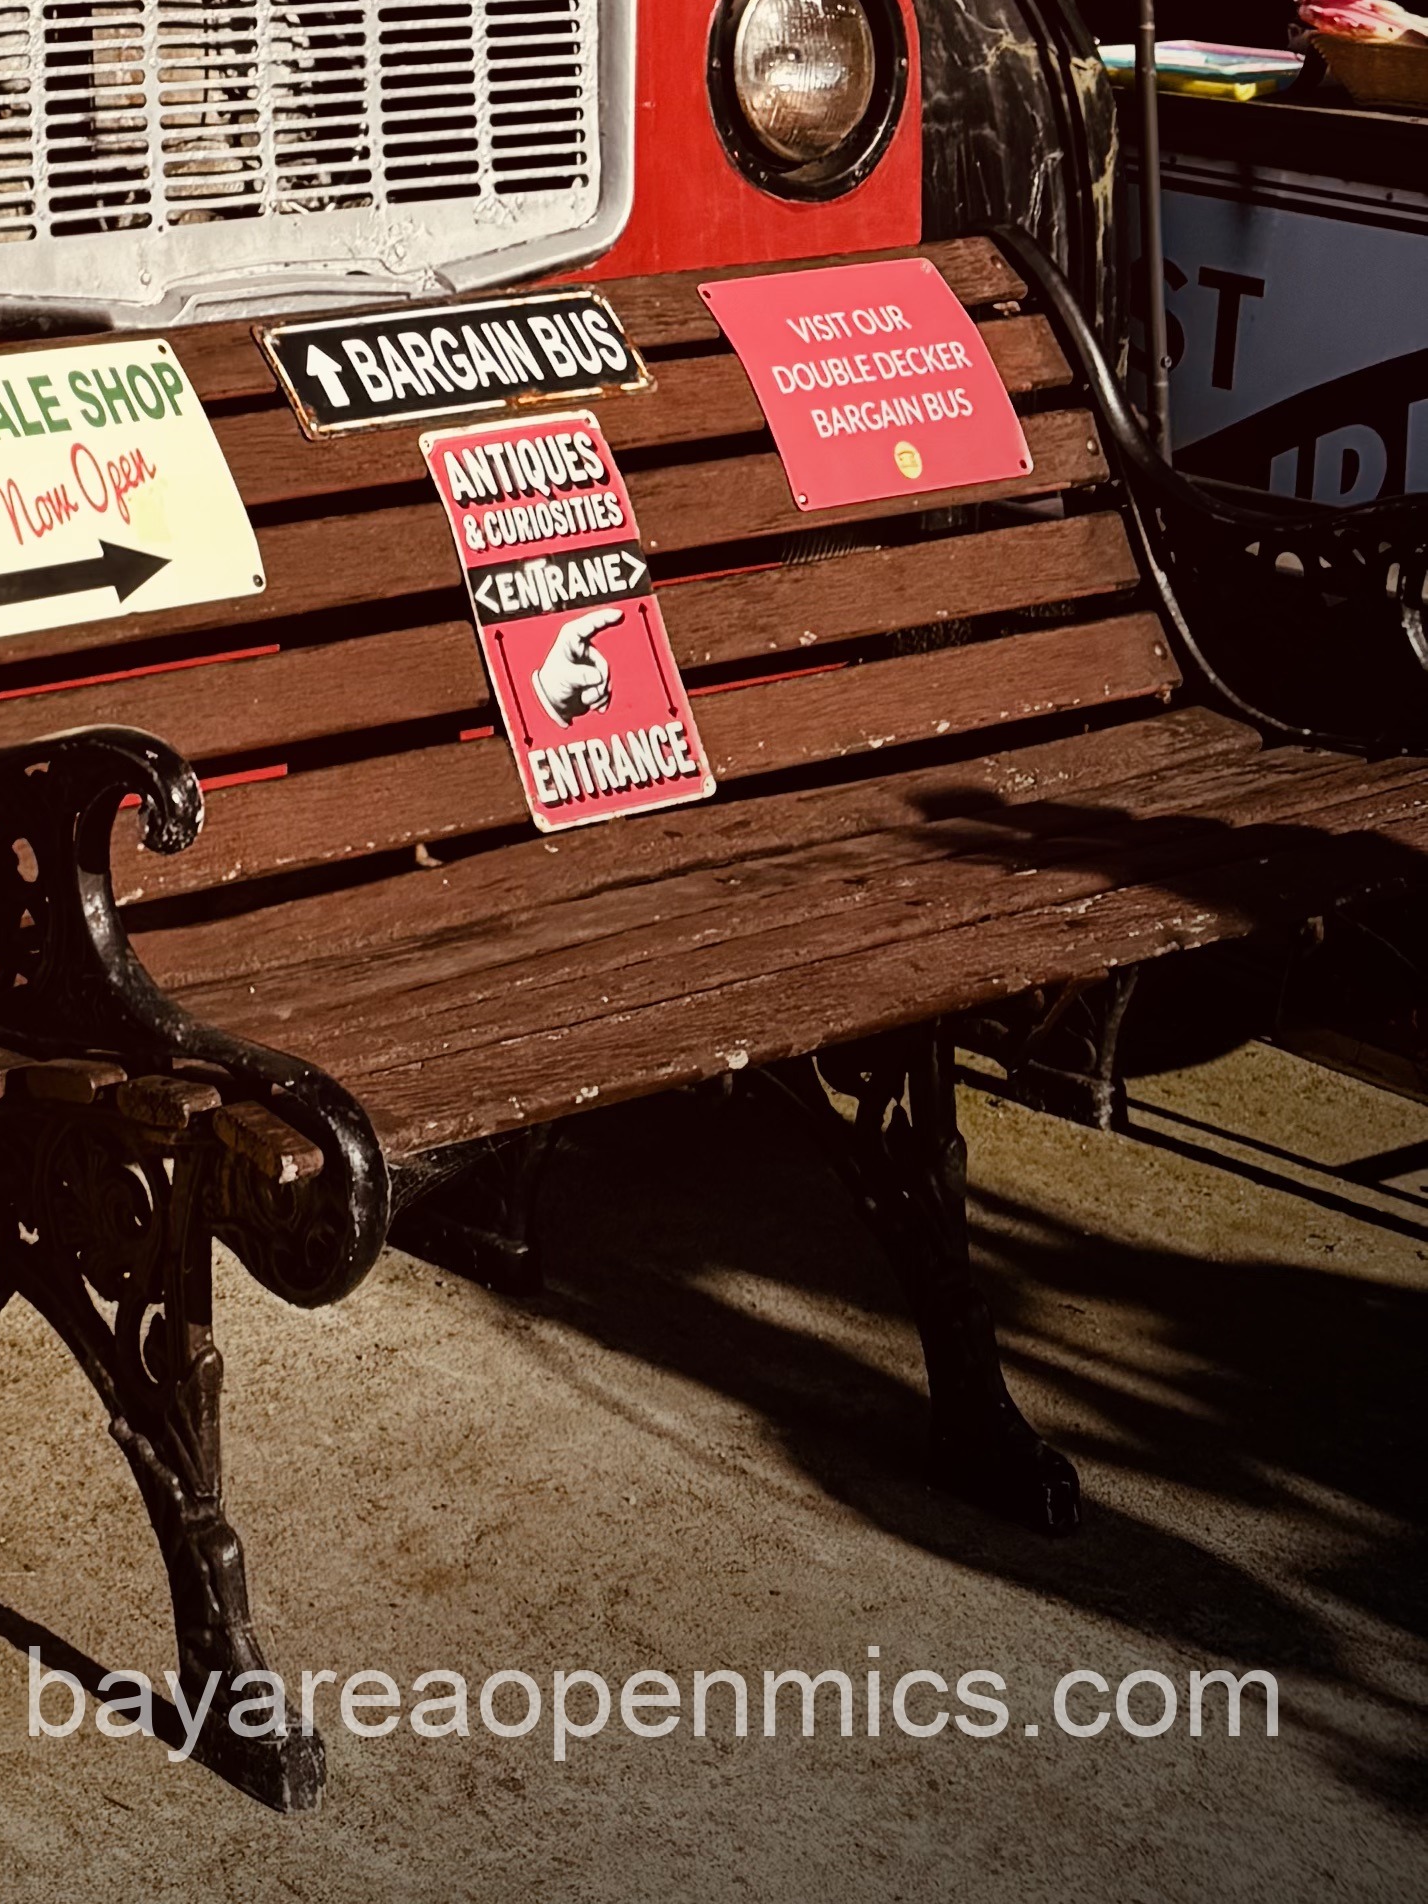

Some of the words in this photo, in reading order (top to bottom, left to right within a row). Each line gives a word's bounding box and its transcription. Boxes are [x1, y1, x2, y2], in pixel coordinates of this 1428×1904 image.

[342, 320, 544, 403] BARGAIN
[528, 309, 628, 378] BUS
[786, 312, 852, 344] VISIT
[851, 305, 912, 335] OUR
[67, 361, 184, 428] SHOP
[772, 354, 876, 394] DOUBLE
[872, 341, 973, 381] DECKER
[811, 397, 924, 438] BARGAIN
[924, 388, 973, 421] BUS
[70, 442, 156, 525] Open
[443, 431, 605, 506] ANTIQUES
[462, 514, 486, 552] &
[481, 492, 624, 547] CURIOSITIES
[528, 721, 695, 803] ENTRANCE
